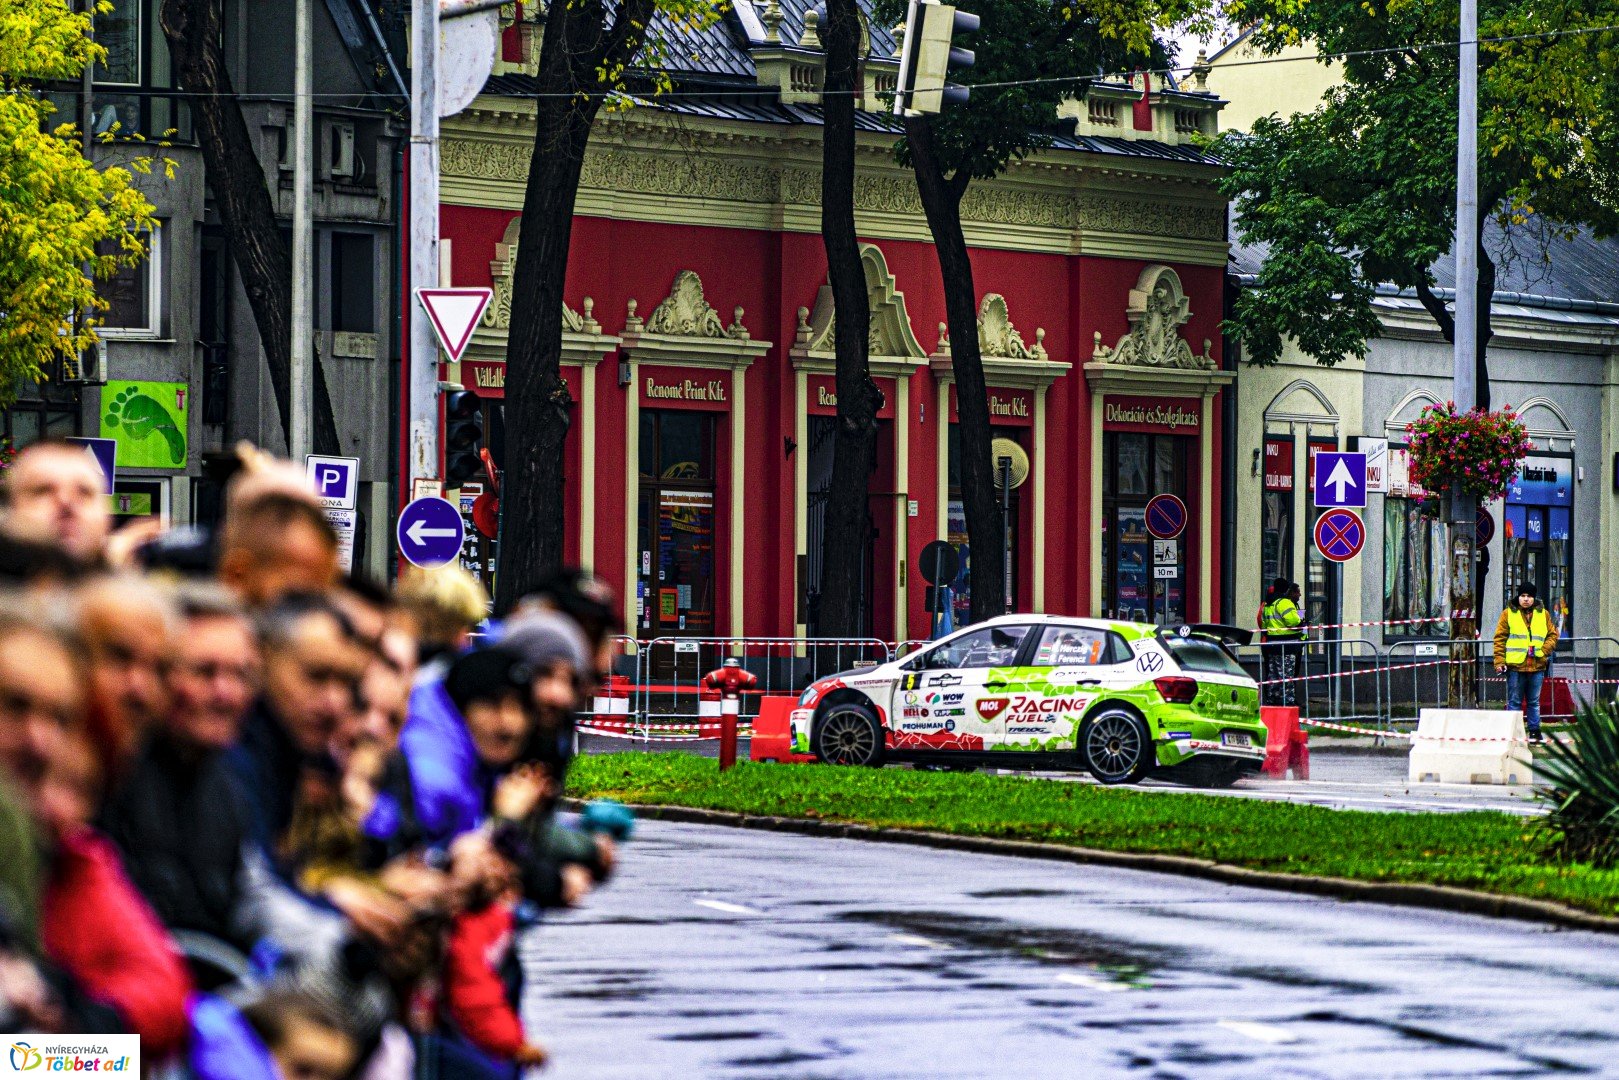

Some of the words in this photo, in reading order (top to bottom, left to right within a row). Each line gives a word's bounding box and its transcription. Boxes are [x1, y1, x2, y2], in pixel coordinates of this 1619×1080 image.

[646, 377, 683, 399] Renomé
[684, 379, 707, 400] Print
[708, 380, 727, 401] Kft.
[991, 396, 1011, 416] Print
[1012, 397, 1029, 417] Kft.
[1106, 403, 1145, 423] Dekoráció
[1146, 407, 1155, 424] és
[1155, 405, 1199, 429] Szolgáltatás
[1266, 443, 1279, 457] INKU
[321, 469, 341, 493] P
[1158, 568, 1166, 576] 10
[1059, 644, 1087, 655] Herczig
[1090, 640, 1101, 665] 5
[1058, 655, 1086, 663] Ferencz
[906, 673, 915, 690] 5
[943, 693, 964, 701] WOW
[980, 701, 999, 711] MOL
[1011, 696, 1087, 714] RACING
[902, 722, 944, 730] PROHUMAN
[1005, 714, 1042, 724] FUEL
